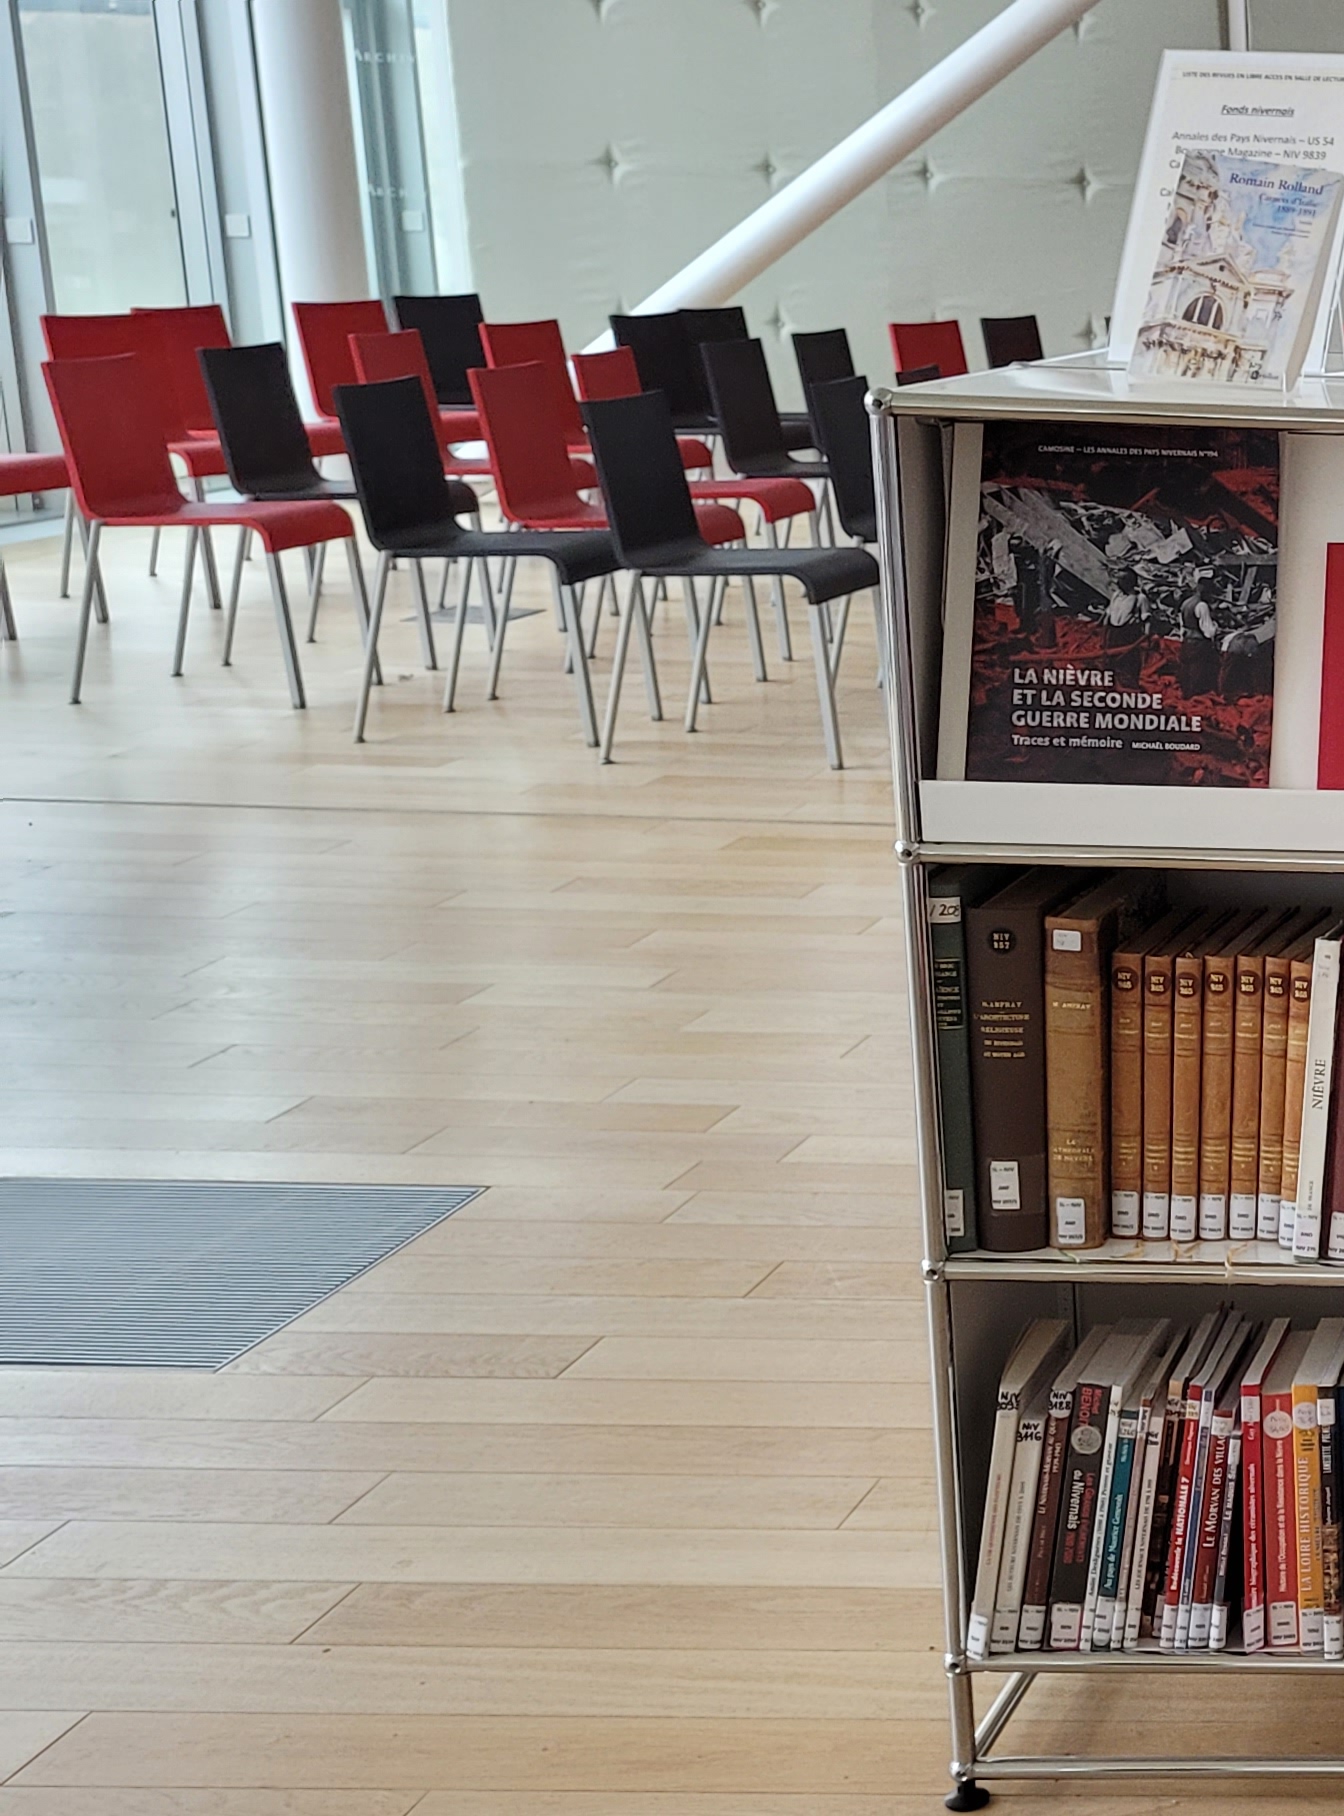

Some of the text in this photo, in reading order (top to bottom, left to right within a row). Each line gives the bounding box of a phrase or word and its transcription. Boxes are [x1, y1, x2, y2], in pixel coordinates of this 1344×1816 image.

[1221, 104, 1296, 117] Fonds nivernais
[1172, 132, 1335, 146] Annales des Pays Nivernais US 54
[1229, 172, 1325, 196] Romain Rolland
[1013, 663, 1114, 687] LA NIÈVRE
[1012, 689, 1163, 709] ET LA SECONDE
[1011, 709, 1202, 732] GUERRE MONDIALE
[1011, 734, 1124, 749] Traces et mémoire
[1311, 1058, 1327, 1110] NIÈVRE
[1298, 1457, 1312, 1592] LA LOIRE HISTORIQUE
